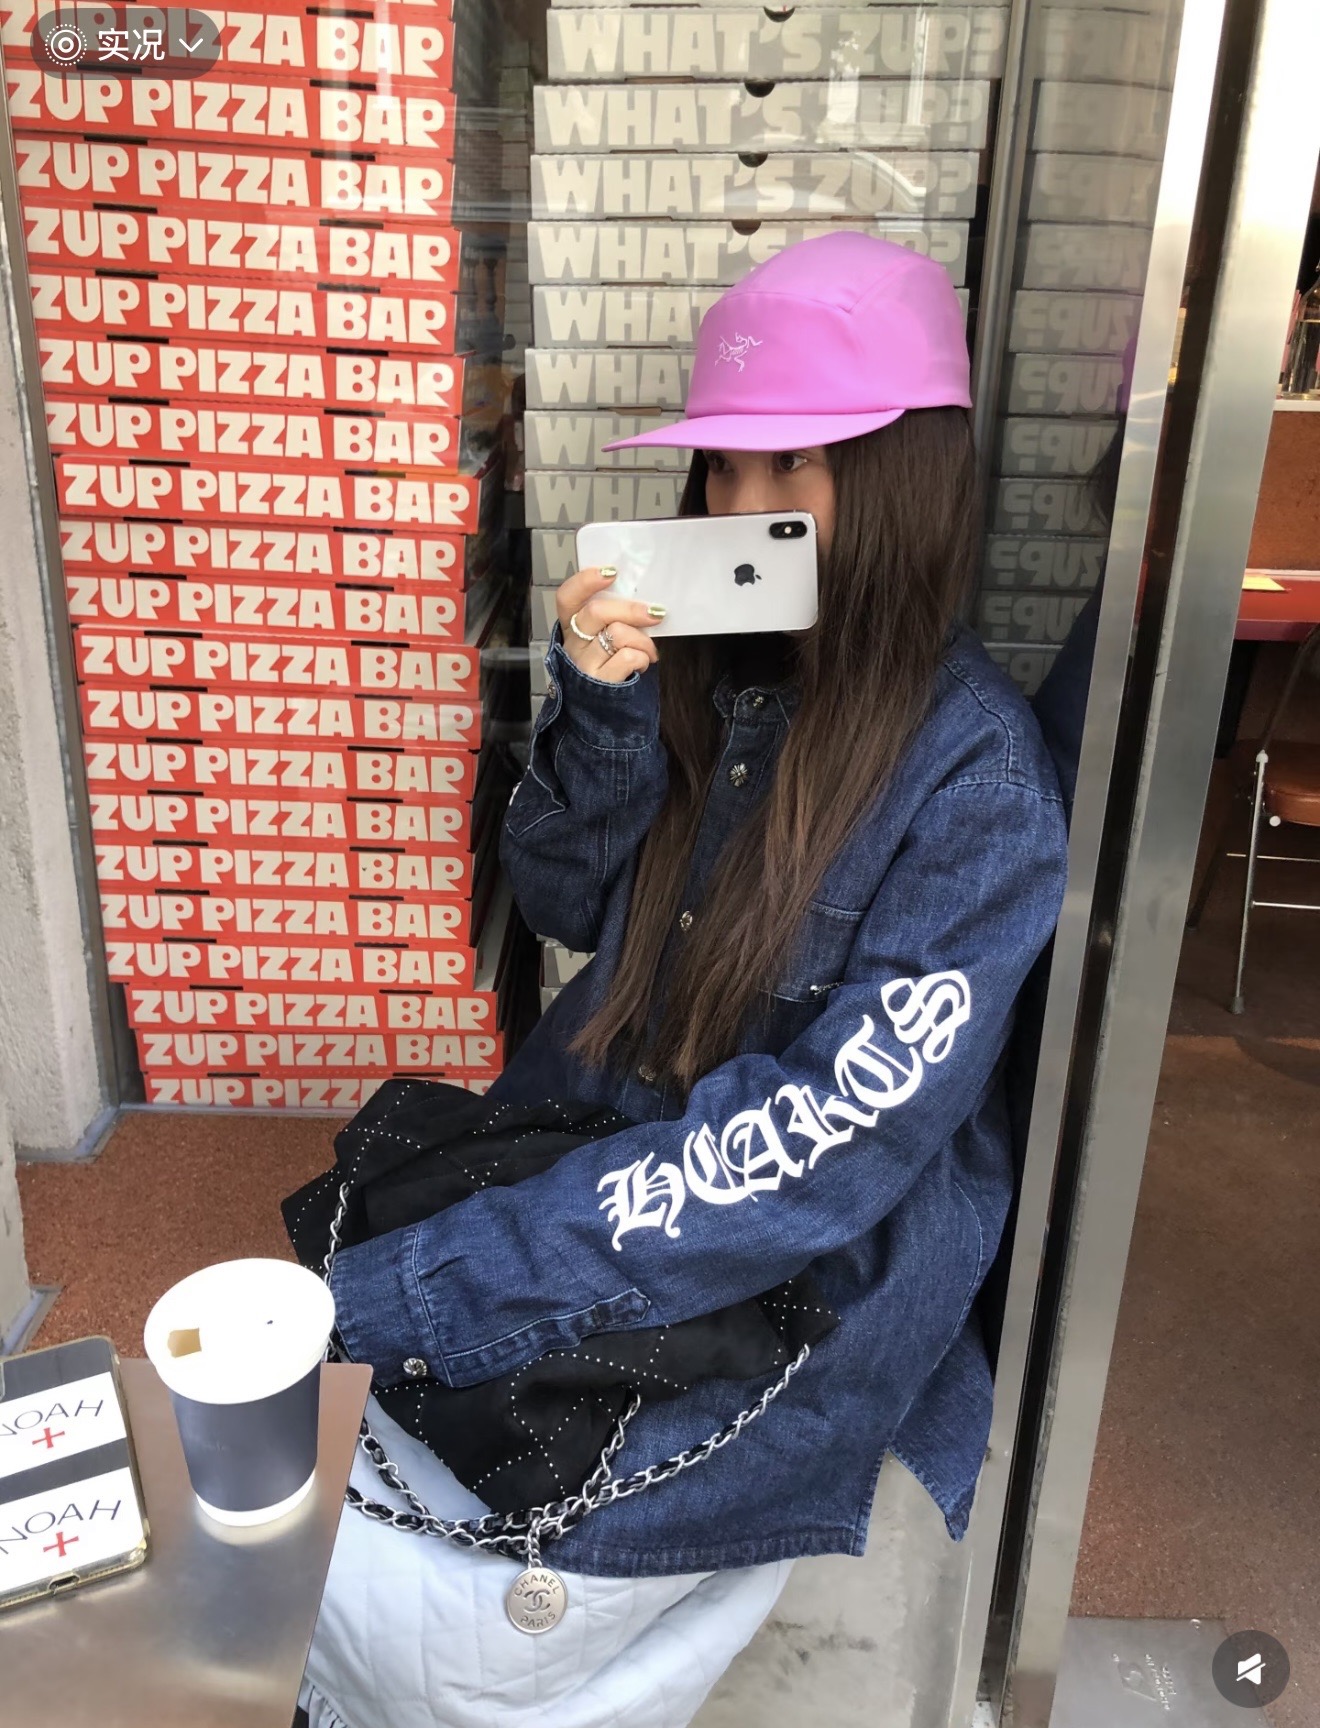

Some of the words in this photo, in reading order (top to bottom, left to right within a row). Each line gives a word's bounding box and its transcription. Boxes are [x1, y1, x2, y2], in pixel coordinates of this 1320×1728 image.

[126, 4, 305, 67] PIZZA
[317, 17, 444, 78] BAR
[5, 69, 123, 123] ZUP
[132, 77, 308, 138] PIZZA
[320, 89, 445, 148] BAR
[17, 138, 129, 192] ZUP
[138, 148, 310, 207] PIZZA
[321, 159, 443, 216] BAR
[25, 206, 138, 259] ZUP
[148, 215, 319, 274] PIZZA
[329, 227, 450, 282] BAR
[31, 273, 139, 324] ZUP
[148, 282, 316, 336] PIZZA
[327, 291, 446, 344] BAR
[39, 338, 150, 387] ZUP
[160, 346, 325, 399] PIZZA
[336, 356, 454, 406] BAR
[46, 402, 151, 448] ZUP
[160, 408, 323, 458] PIZZA
[334, 416, 450, 466] BAR
[63, 464, 172, 508] ZUP
[181, 469, 344, 518] PIZZA
[355, 478, 469, 524] BAR
[60, 520, 165, 565] ZUP
[174, 526, 332, 574] PIZZA
[343, 534, 455, 580] BAR
[67, 577, 169, 619] ZUP
[178, 582, 334, 629] PIZZA
[345, 589, 456, 636] BAR
[82, 636, 185, 677] ZUP
[193, 640, 350, 686] PIZZA
[361, 648, 471, 692] BAR
[88, 690, 191, 729] ZUP
[199, 694, 354, 736] PIZZA
[364, 701, 473, 741] BAR
[83, 743, 186, 781] ZUP
[194, 746, 346, 788] PIZZA
[357, 752, 464, 793] BAR
[89, 794, 187, 832] ZUP
[195, 797, 346, 838] PIZZA
[356, 803, 462, 842] BAR
[94, 844, 192, 881] ZUP
[200, 848, 348, 887] PIZZA
[359, 852, 463, 890] BAR
[100, 893, 193, 929] ZUP
[202, 897, 348, 935] PIZZA
[358, 901, 461, 938] BAR
[105, 942, 200, 977] ZUP
[208, 944, 353, 981] PIZZA
[363, 948, 465, 984] BAR
[132, 991, 227, 1023] ZUP
[235, 993, 378, 1027] PIZZA
[388, 995, 488, 1029] BAR
[144, 1034, 237, 1065] ZUP
[245, 1034, 386, 1065] PIZZA
[397, 1035, 495, 1066] BAR
[150, 1078, 246, 1107] ZUP
[514, 1574, 560, 1596] CHANEL
[521, 1612, 556, 1627] PARIS
